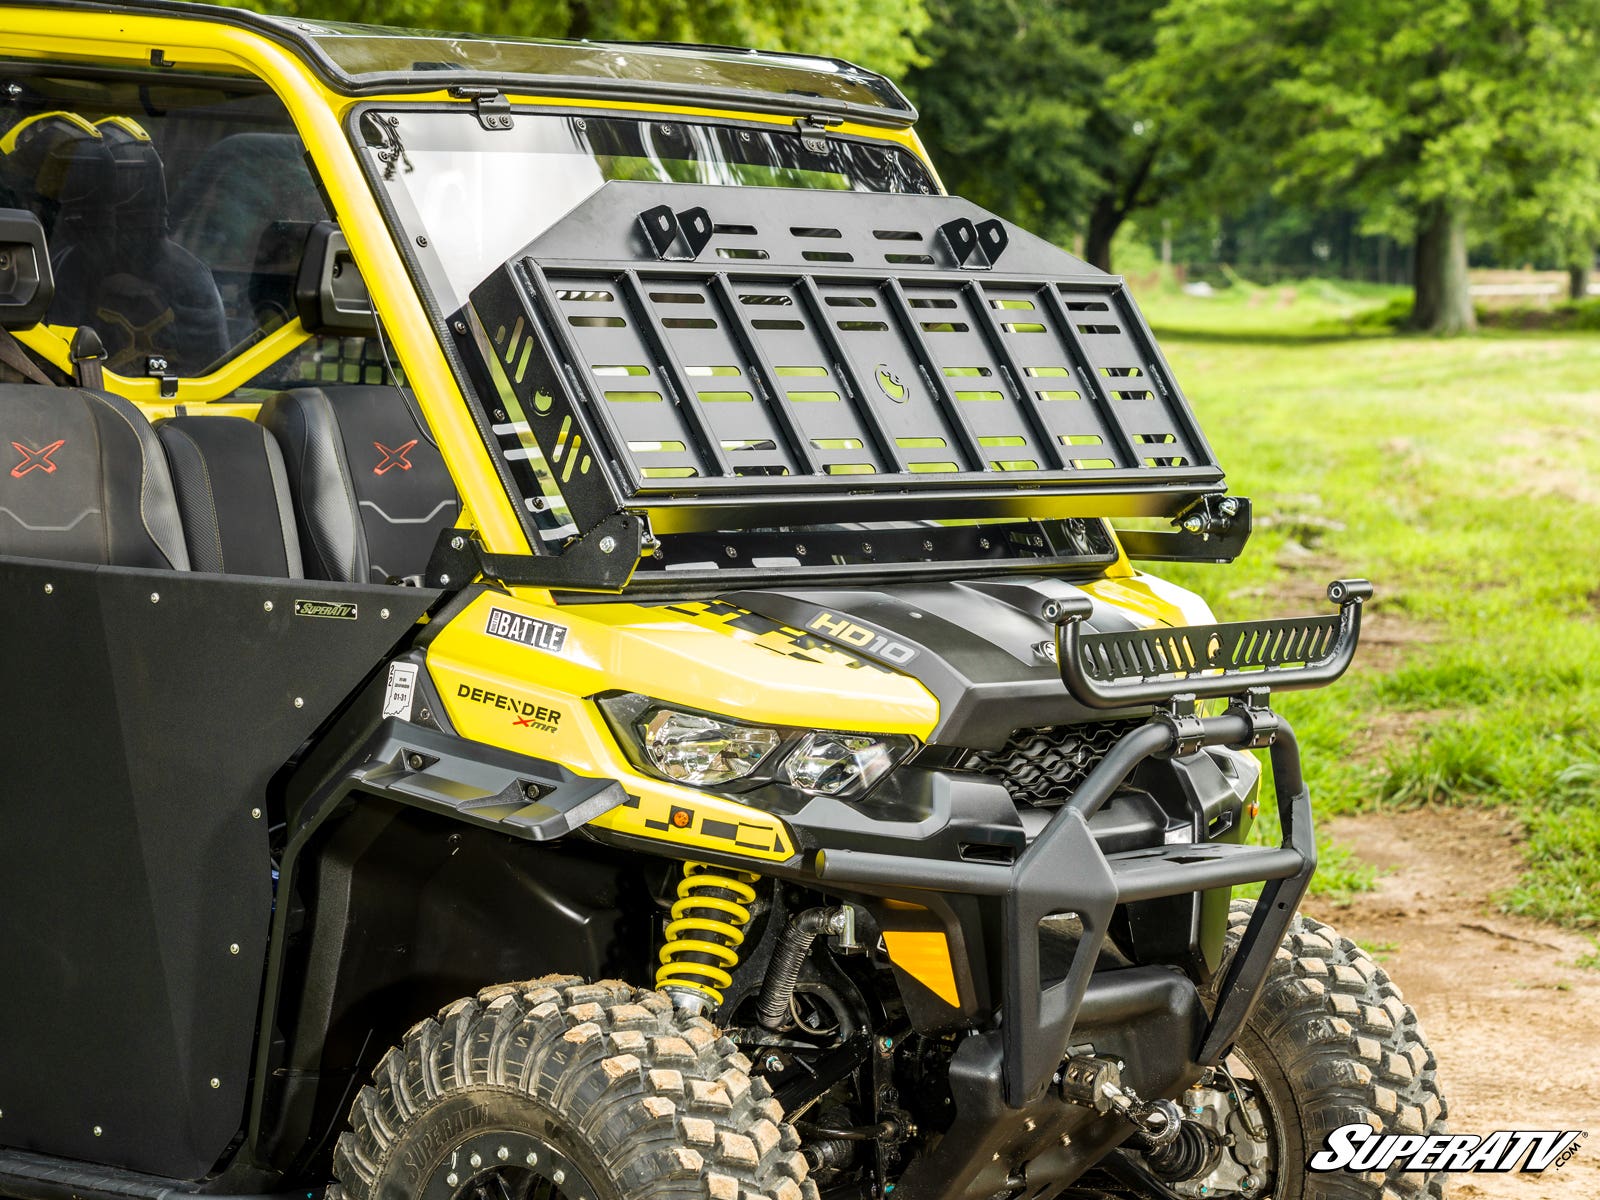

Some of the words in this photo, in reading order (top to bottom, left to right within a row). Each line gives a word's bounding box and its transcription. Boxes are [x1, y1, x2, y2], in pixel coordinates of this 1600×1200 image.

[300, 603, 352, 616] SUPERATV
[497, 613, 562, 651] BATTLE
[810, 613, 915, 664] HD10
[457, 684, 562, 725] DEFENDER
